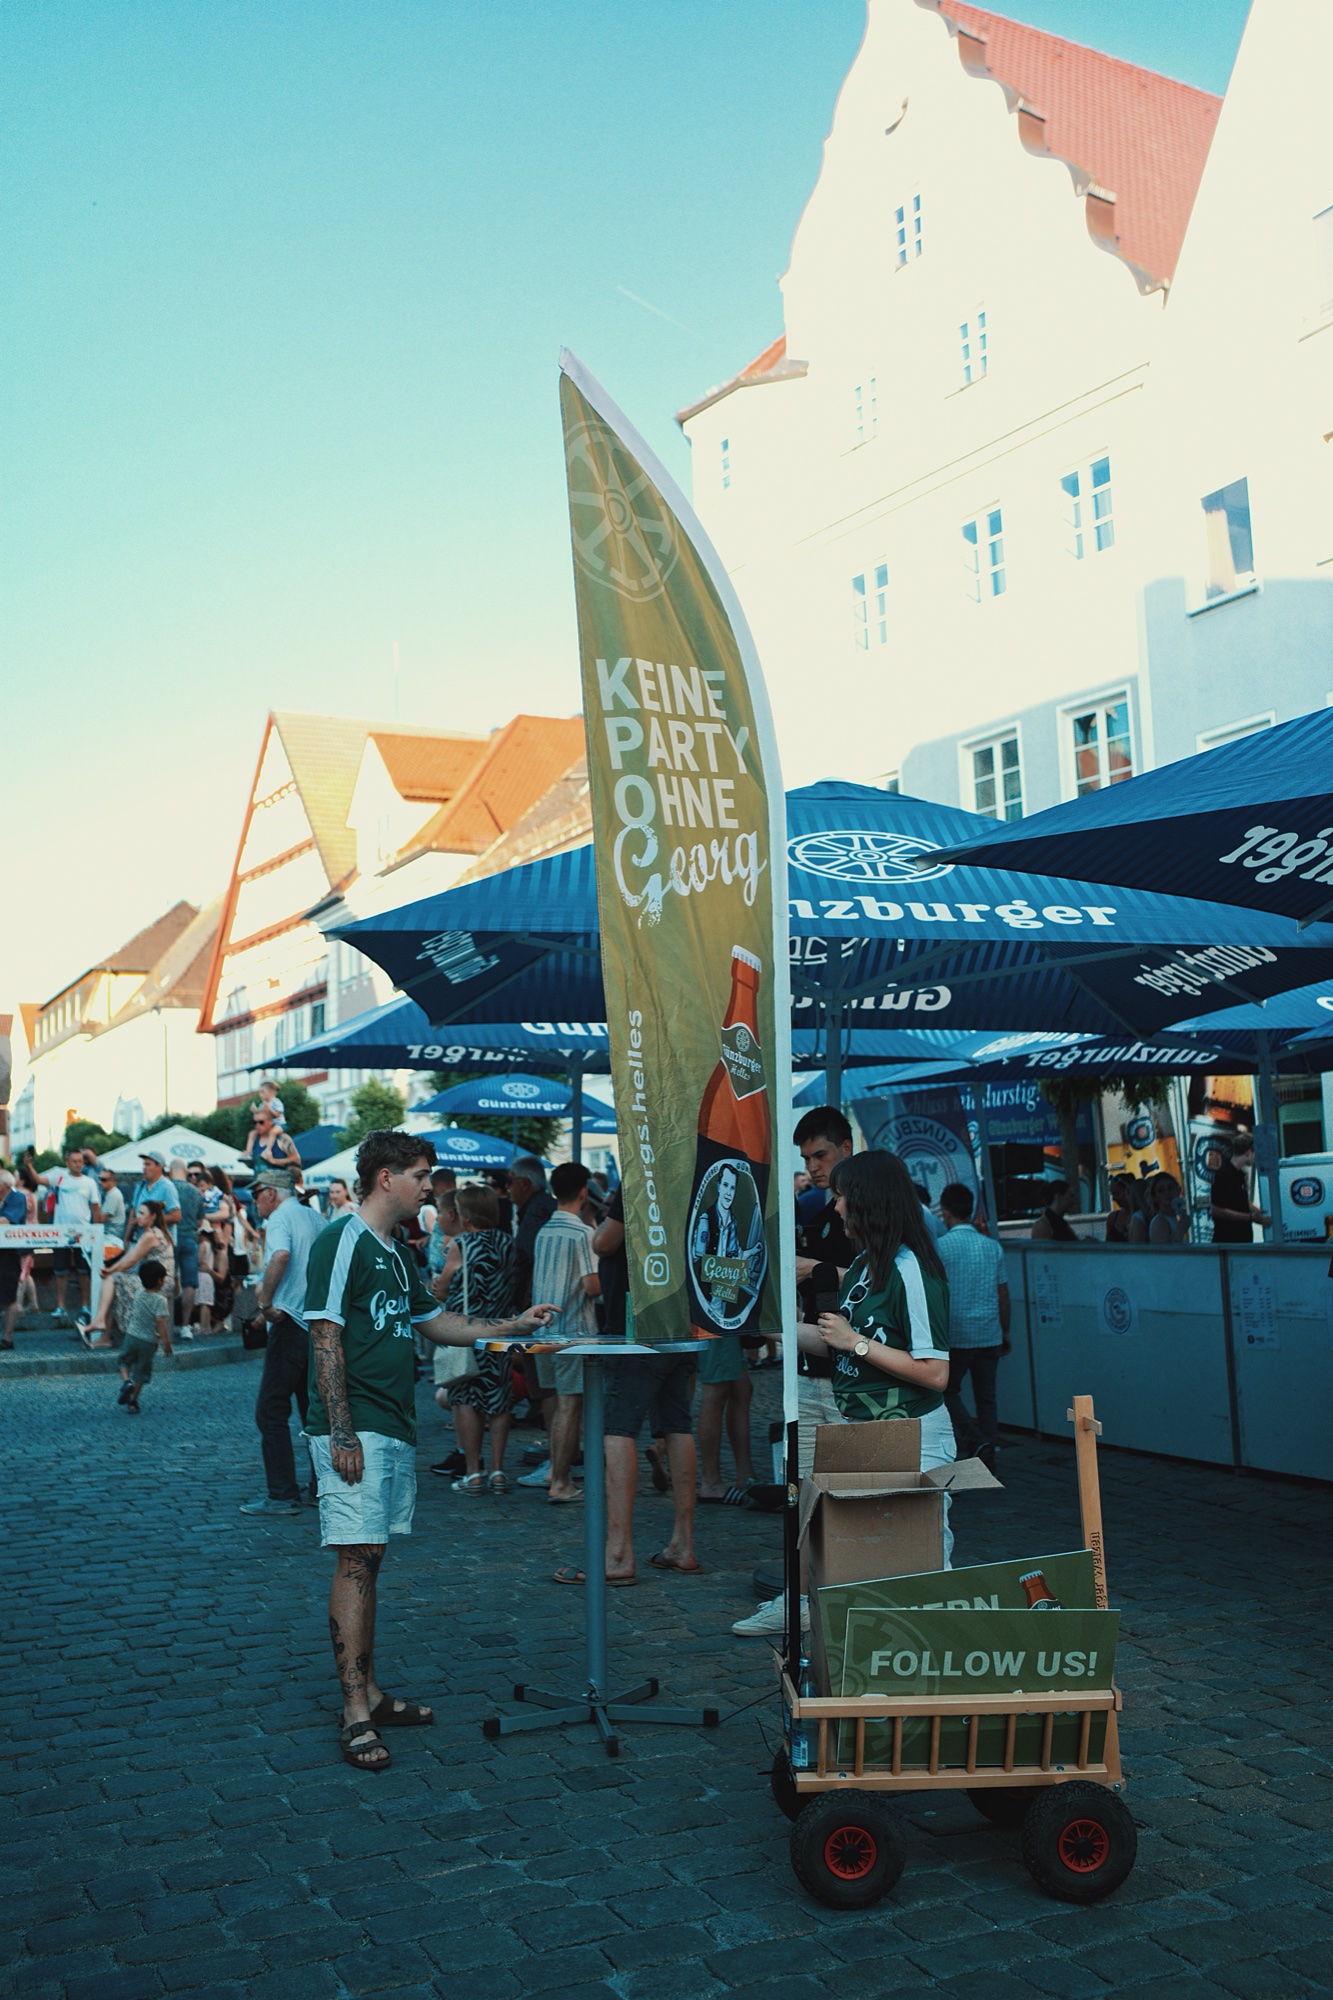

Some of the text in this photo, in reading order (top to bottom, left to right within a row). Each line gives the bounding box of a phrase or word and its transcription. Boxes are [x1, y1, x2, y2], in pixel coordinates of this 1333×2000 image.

[595, 657, 727, 720] KEINE
[604, 716, 749, 774] PARTY
[613, 774, 740, 829] OHNE
[613, 823, 767, 929] Georg
[789, 896, 1117, 928] nzburger
[478, 1099, 566, 1111] Günzburger
[436, 1153, 506, 1164] ünzburger
[704, 1257, 748, 1287] Georg's
[1093, 1583, 1107, 1609] rger
[870, 1650, 1098, 1677] FOLLOW US!
